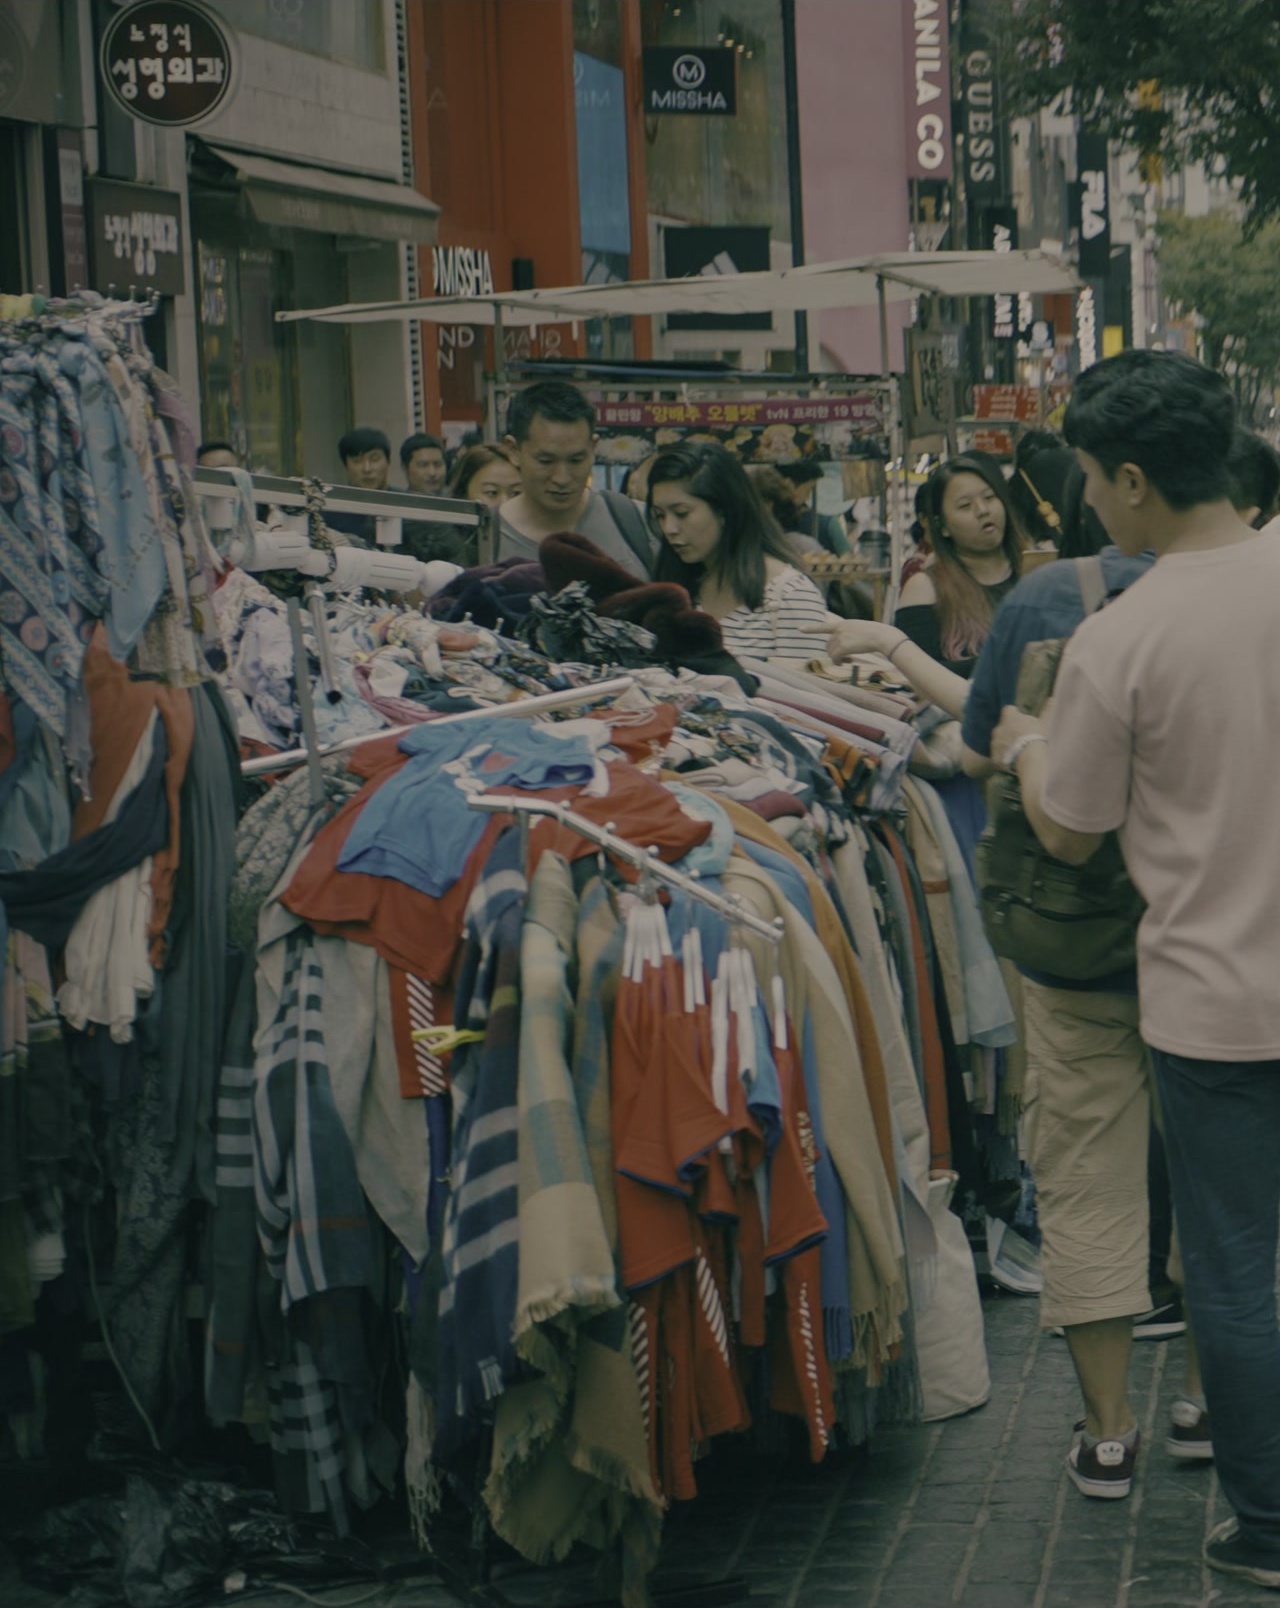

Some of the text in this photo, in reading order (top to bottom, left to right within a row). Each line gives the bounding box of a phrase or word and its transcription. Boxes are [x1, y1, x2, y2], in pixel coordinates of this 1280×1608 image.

[111, 56, 224, 100] 성형외과
[651, 89, 728, 110] MISSHA
[965, 50, 996, 183] GUESS
[916, 114, 945, 170] CO
[440, 246, 494, 296] MISSHA
[765, 407, 790, 420] tvN
[833, 403, 850, 418] 19
